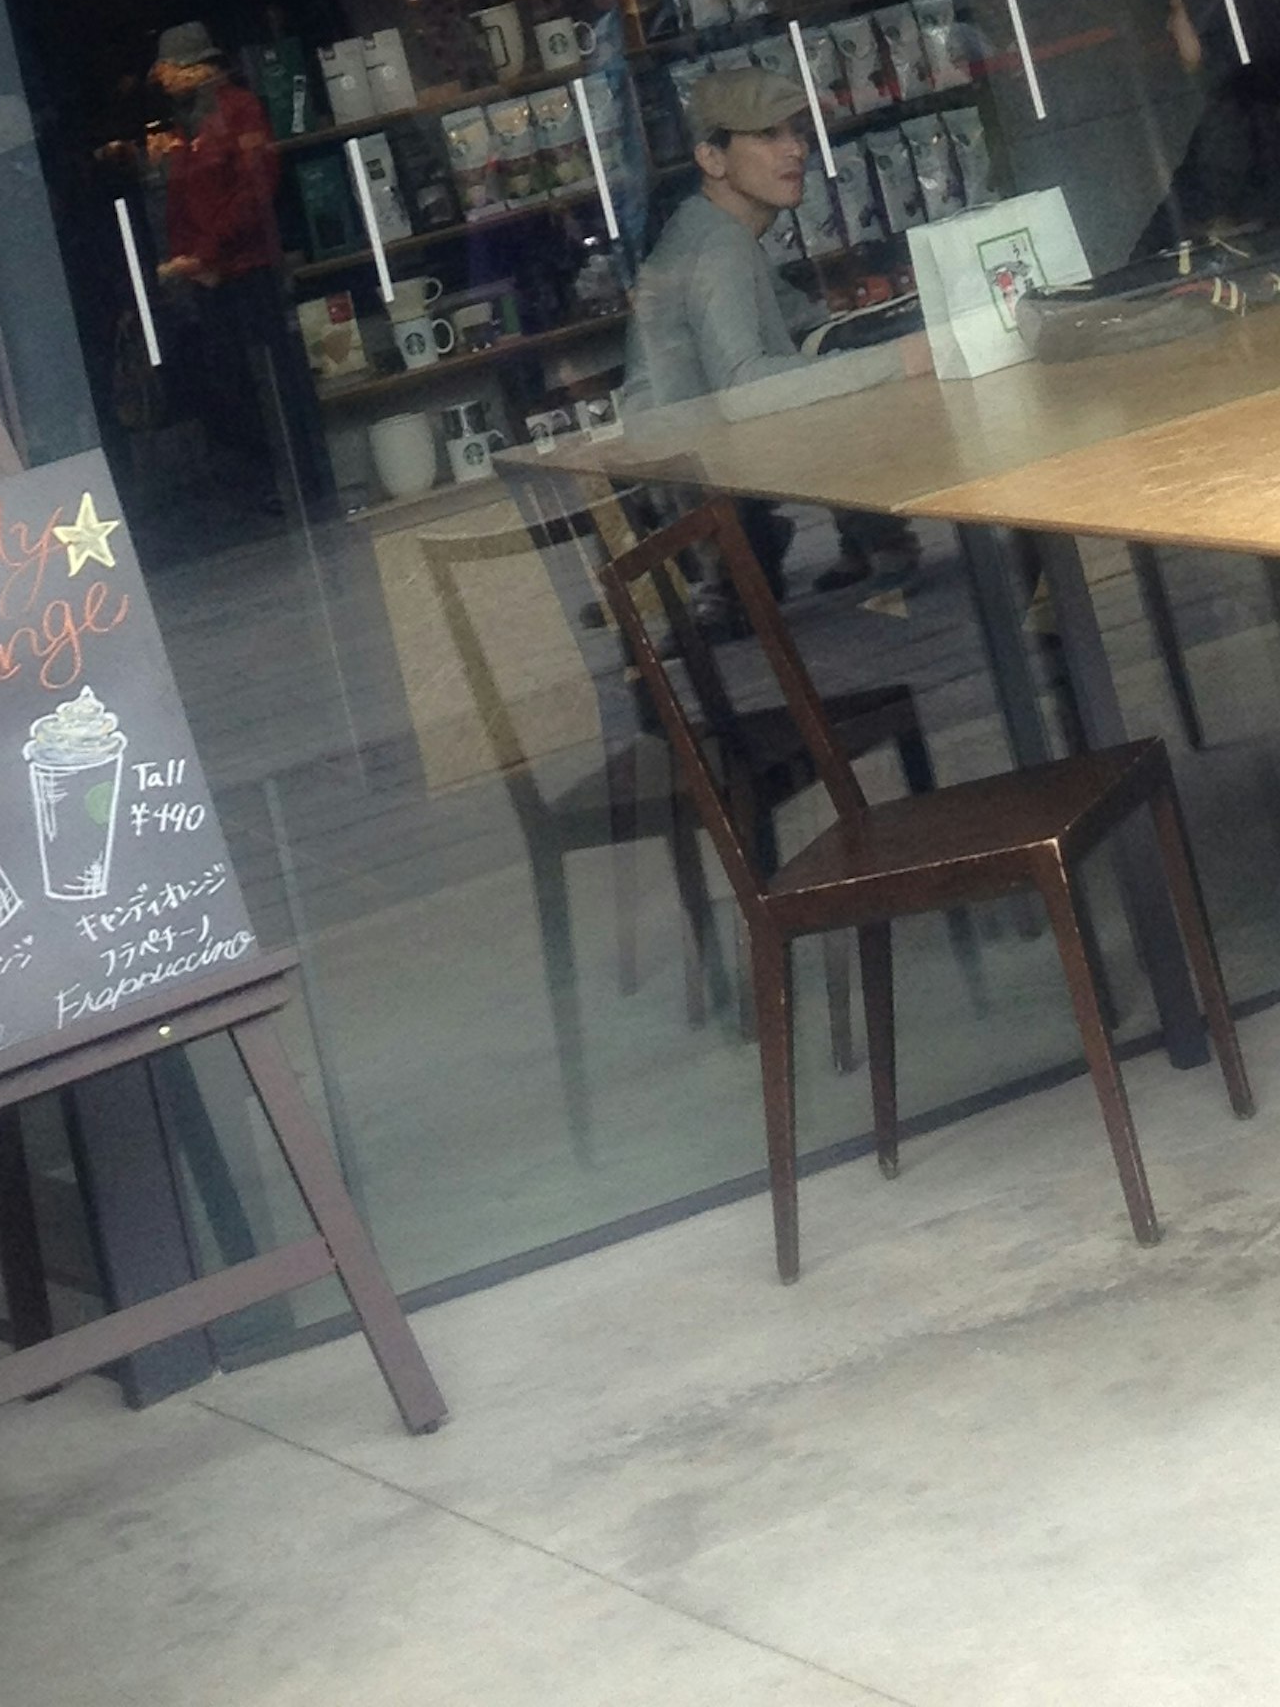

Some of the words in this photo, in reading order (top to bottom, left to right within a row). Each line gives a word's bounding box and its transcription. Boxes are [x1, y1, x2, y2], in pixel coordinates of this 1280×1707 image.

[131, 758, 186, 791] Tall
[130, 801, 206, 837] ¥490
[75, 863, 227, 942] キャンディオレンジ
[100, 914, 210, 978] フラペチーノ
